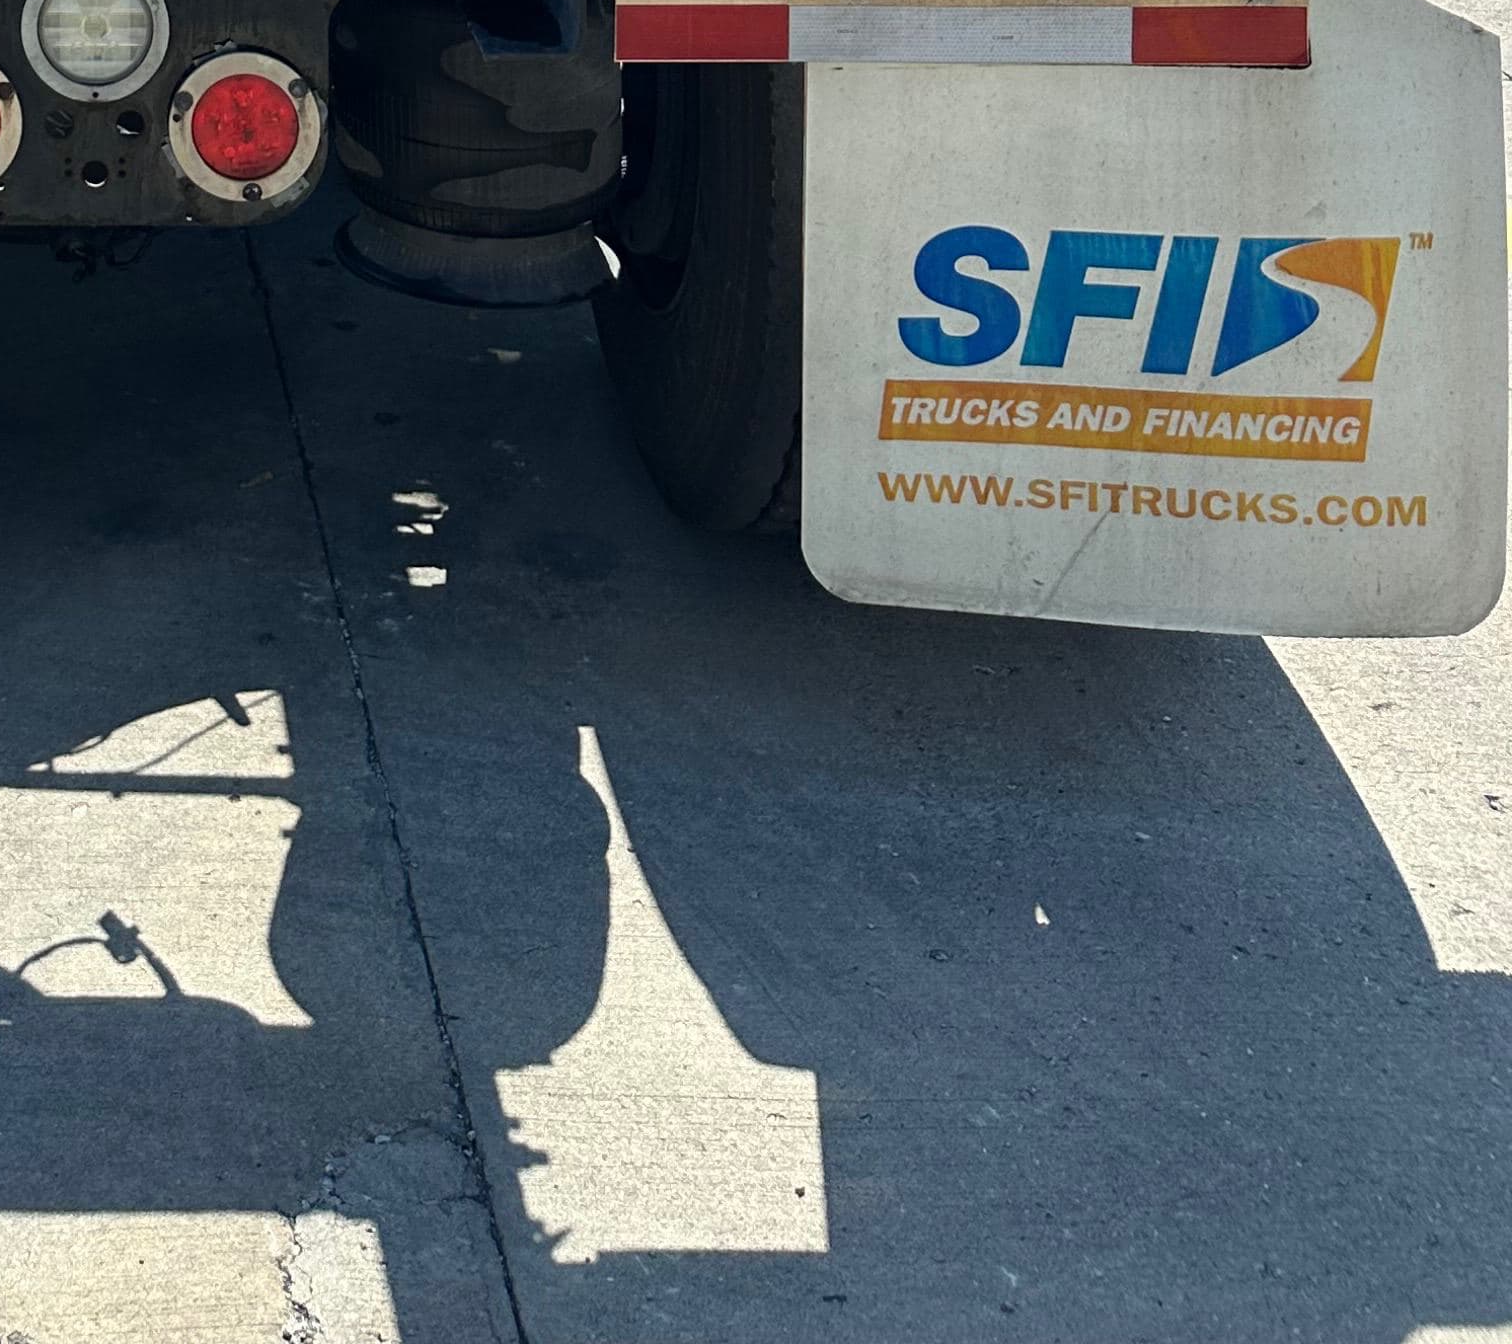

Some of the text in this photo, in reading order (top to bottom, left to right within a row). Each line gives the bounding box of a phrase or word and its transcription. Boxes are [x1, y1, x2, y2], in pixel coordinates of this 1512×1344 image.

[890, 397, 1362, 445] TRUCKS AND FINANCING
[877, 471, 1428, 528] WWW.SFITRUCKS.COM
